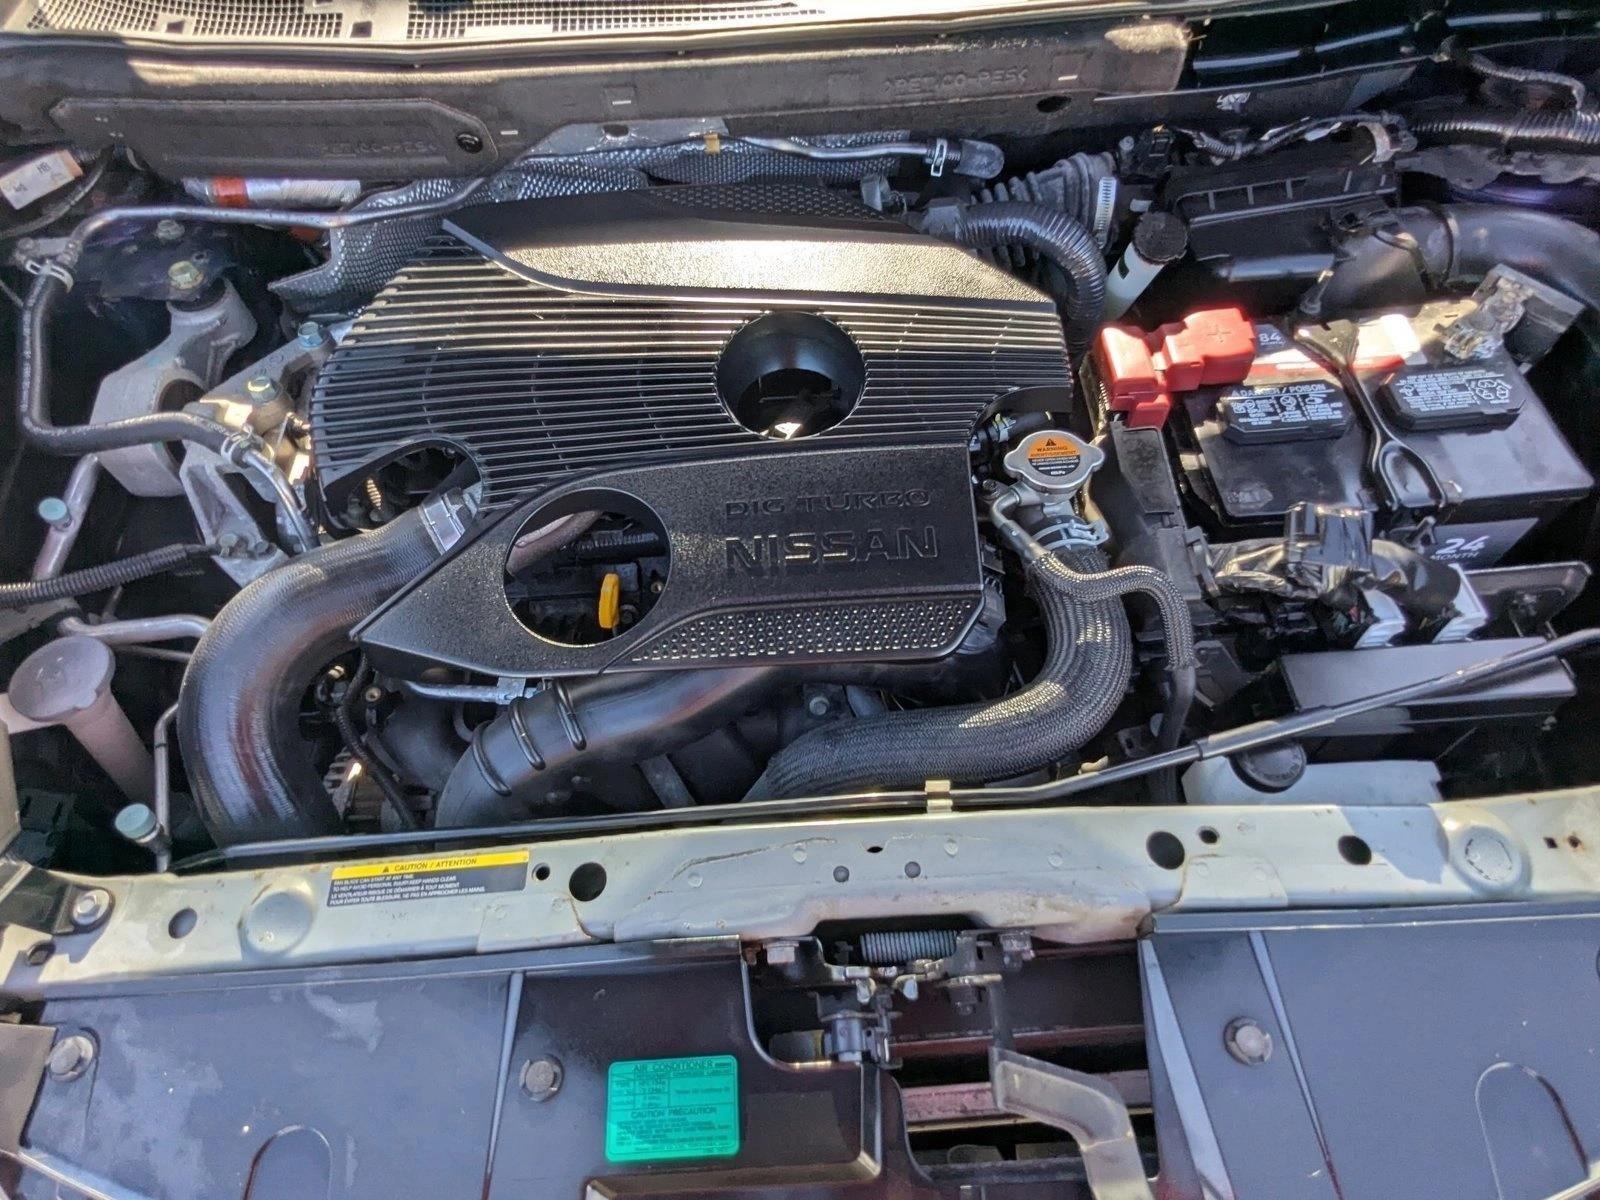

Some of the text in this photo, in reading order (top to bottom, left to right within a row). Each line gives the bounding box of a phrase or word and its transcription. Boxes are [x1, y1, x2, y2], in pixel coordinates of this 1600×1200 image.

[725, 488, 931, 516] DIG TURBO
[725, 526, 938, 577] NISSAN
[1435, 535, 1490, 555] 24
[394, 862, 427, 872] CAUTION
[436, 858, 477, 867] ATTENTION
